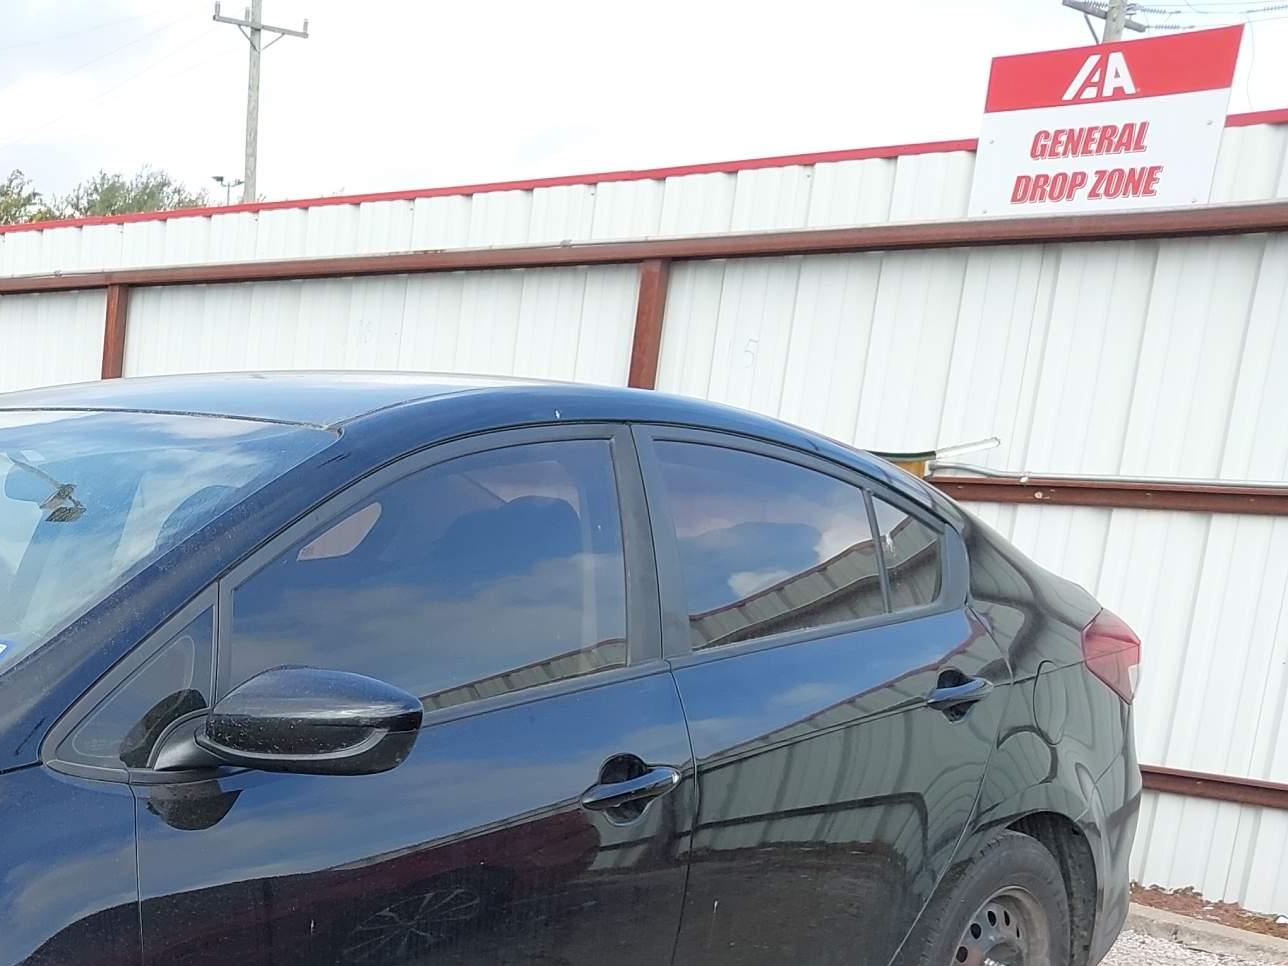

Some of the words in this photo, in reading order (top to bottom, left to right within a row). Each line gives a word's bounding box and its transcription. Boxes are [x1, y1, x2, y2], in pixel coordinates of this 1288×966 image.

[1030, 121, 1149, 160] GENERAL
[1011, 171, 1088, 204] DROP
[1087, 165, 1164, 199] ZONE
